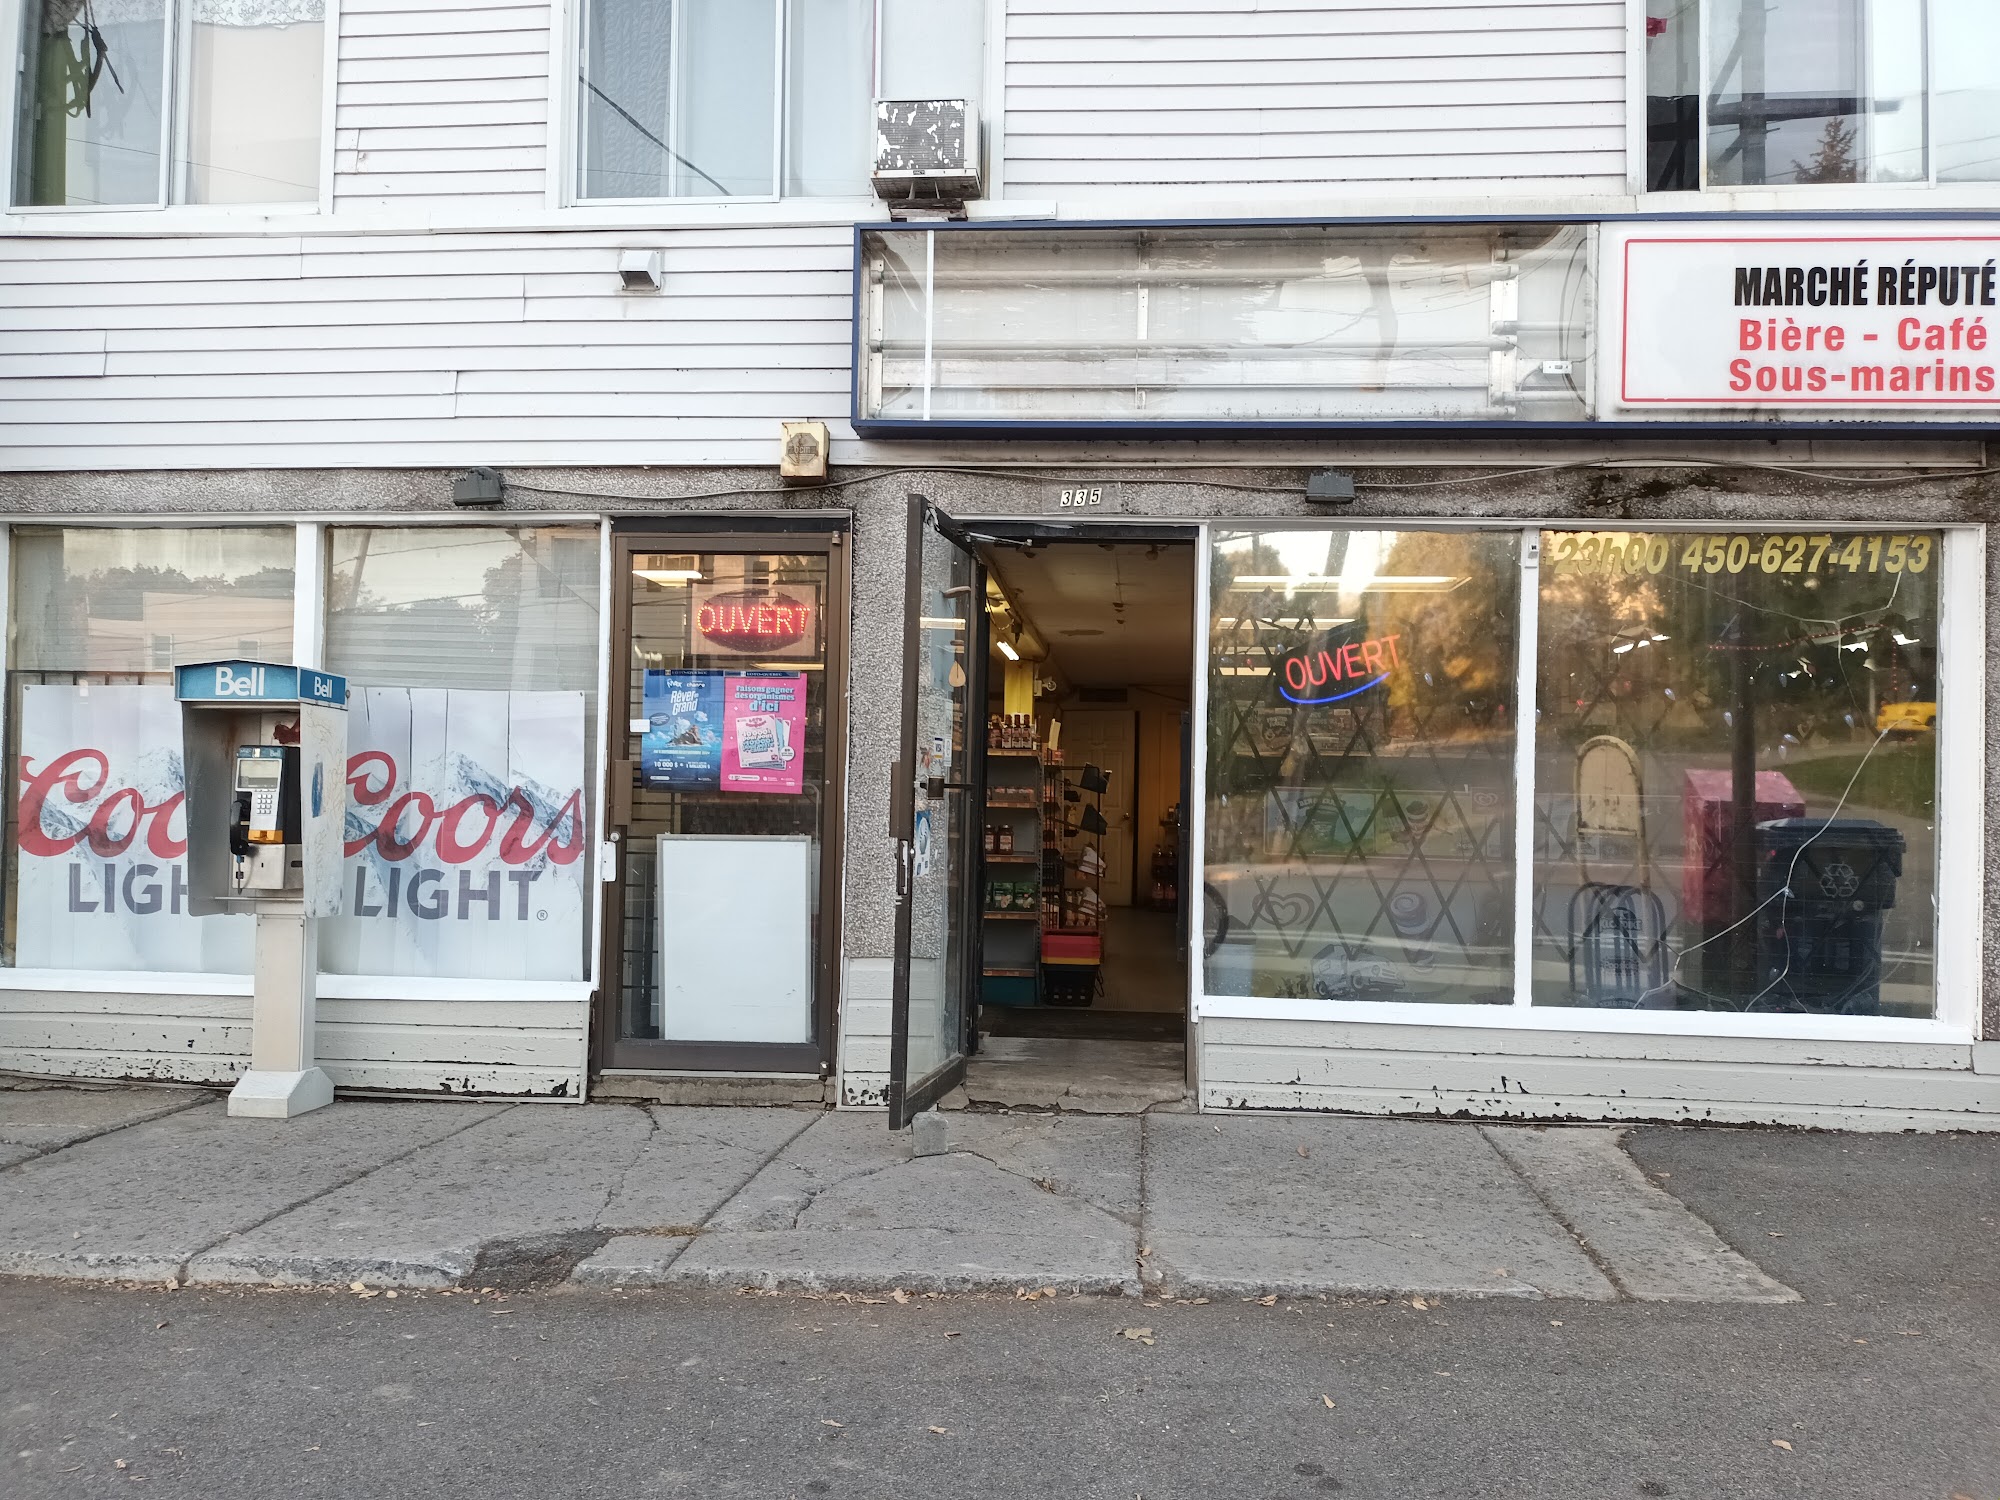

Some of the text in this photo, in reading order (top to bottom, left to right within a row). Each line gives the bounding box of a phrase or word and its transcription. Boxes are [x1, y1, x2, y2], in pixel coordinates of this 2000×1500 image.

[1734, 258, 1997, 307] MARCHÉ RÉPUTÉ
[1739, 317, 1846, 351] Bière
[1897, 317, 1988, 351] Café
[1729, 358, 1996, 393] Sous-marins
[1681, 534, 1932, 574] 450-627-4153
[696, 606, 811, 635] OUVERT
[215, 666, 265, 697] Bell
[1284, 634, 1402, 691] OUVERT
[314, 676, 333, 699] Bell
[749, 700, 779, 712] d'ici
[18, 748, 187, 859] Coo
[345, 750, 585, 864] Coors
[69, 863, 188, 914] LIG
[354, 865, 542, 921] LIGHT
